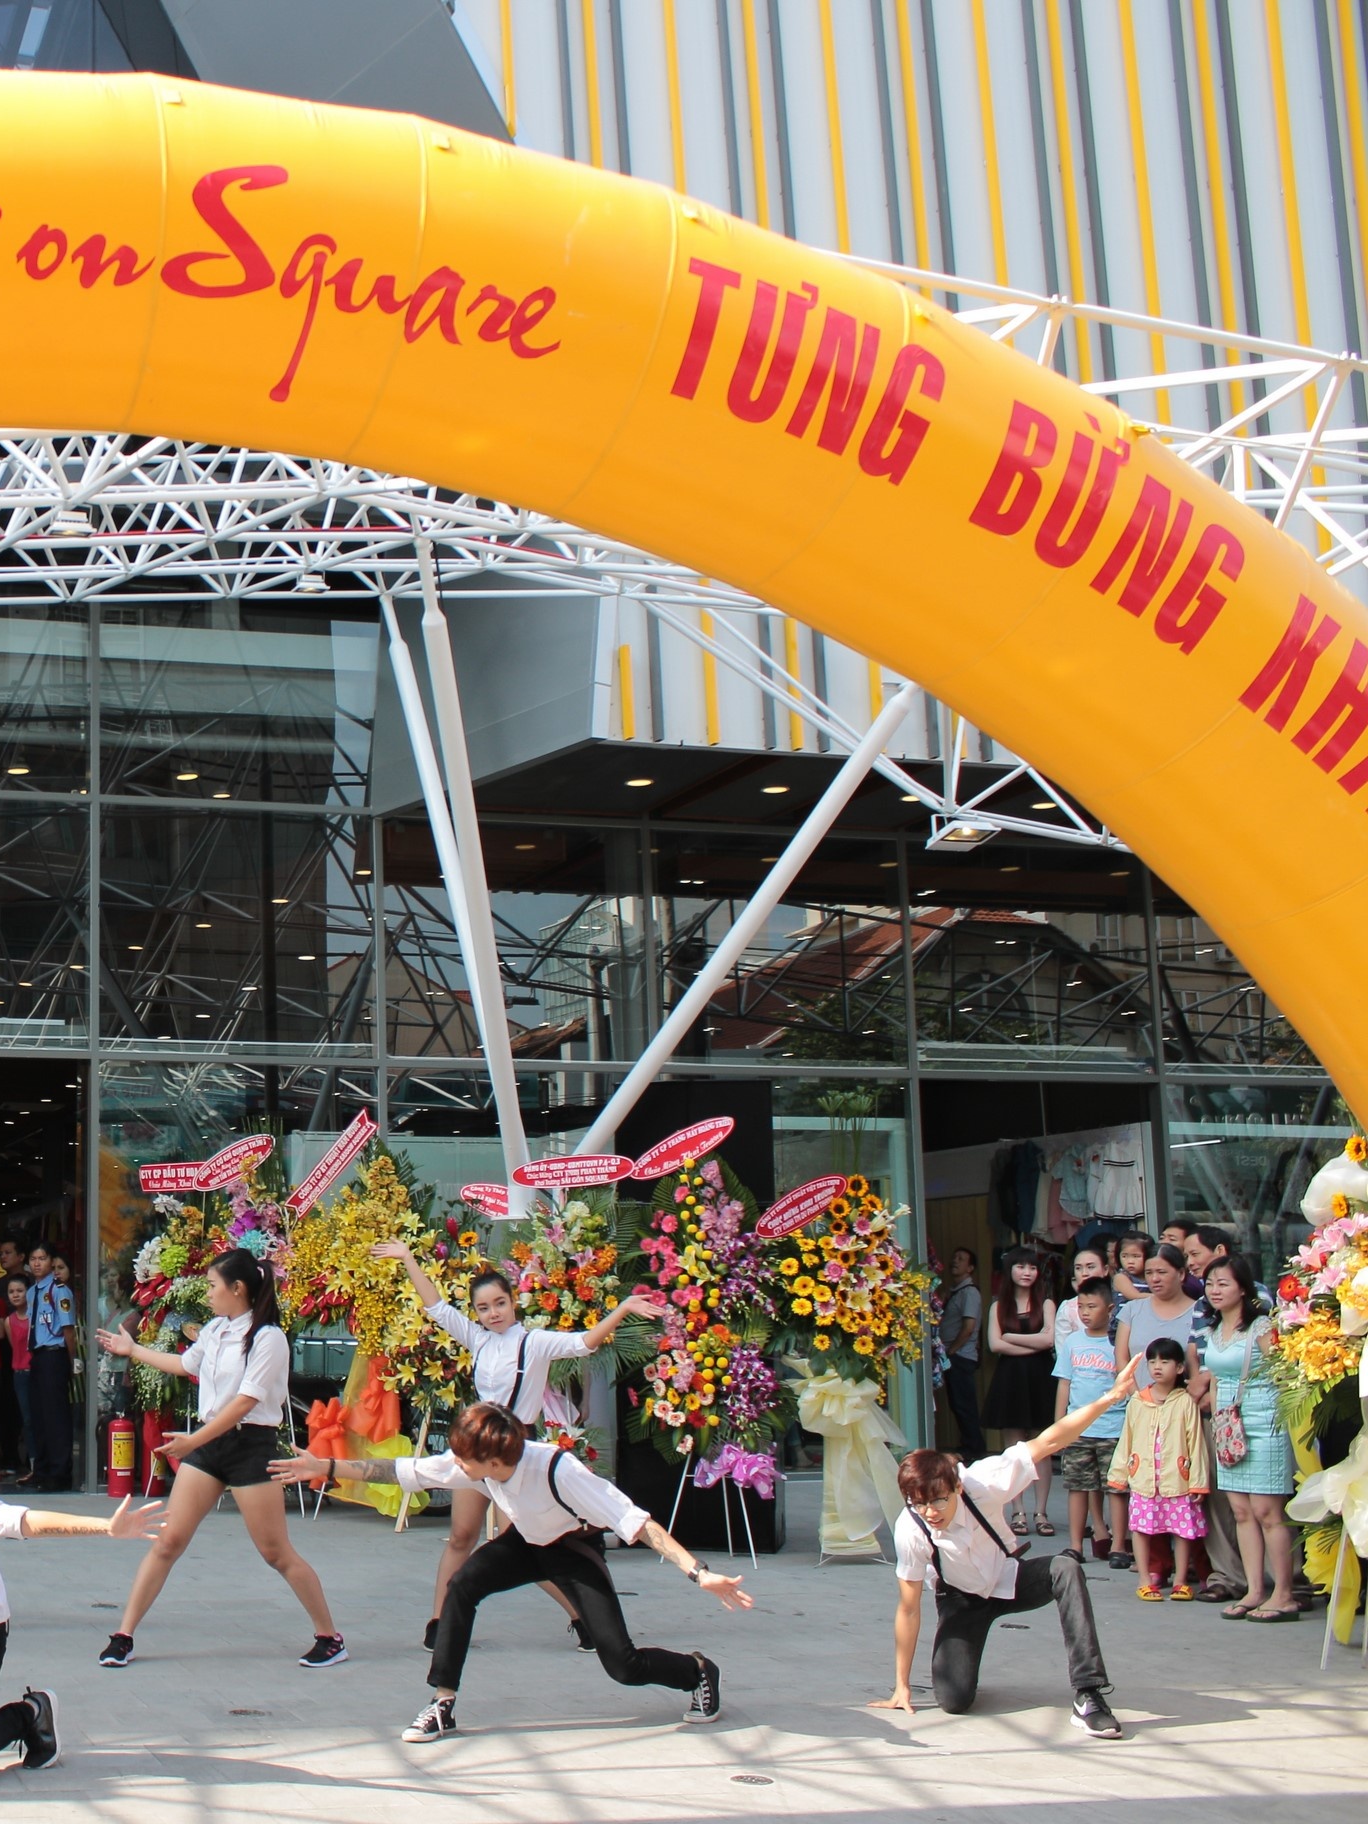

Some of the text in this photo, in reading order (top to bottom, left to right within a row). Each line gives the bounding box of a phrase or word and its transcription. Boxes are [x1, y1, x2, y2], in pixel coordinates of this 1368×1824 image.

[160, 164, 561, 402] Square
[670, 256, 946, 487] TƯNG
[969, 400, 1245, 656] BỪNG
[141, 1169, 151, 1179] CTY
[153, 1169, 161, 1178] CP
